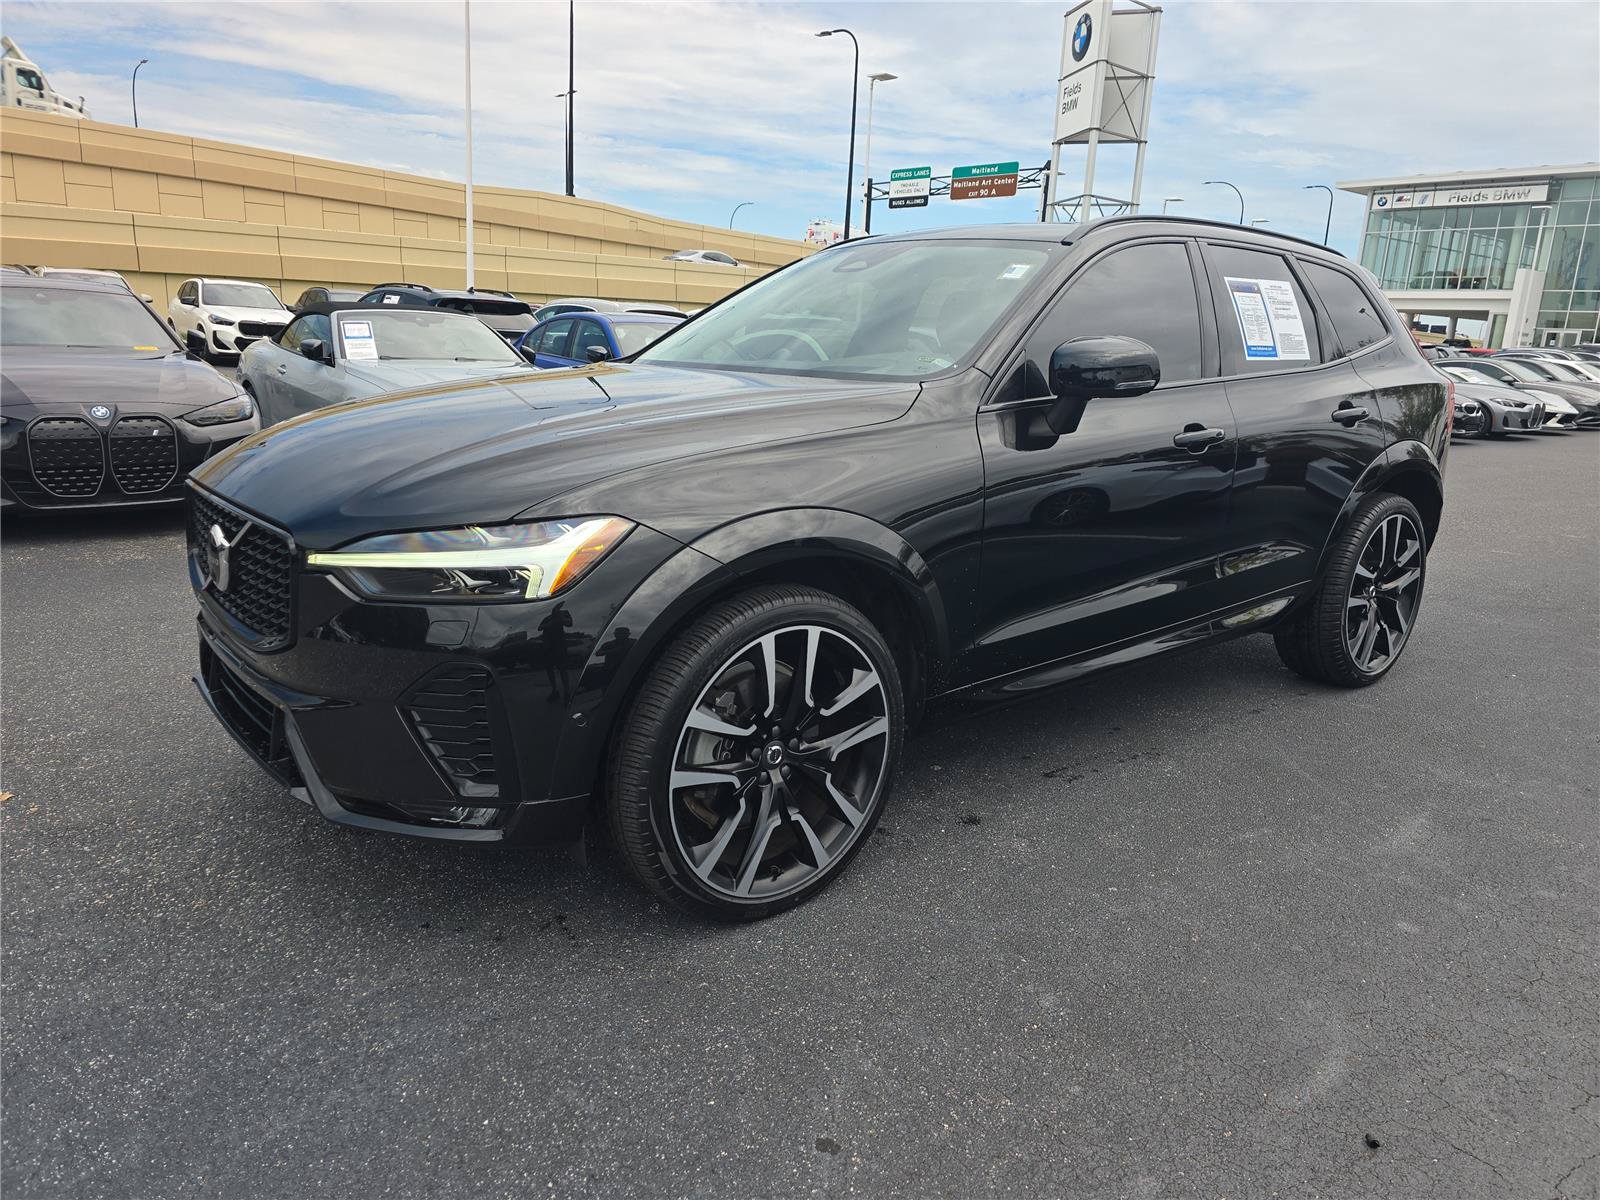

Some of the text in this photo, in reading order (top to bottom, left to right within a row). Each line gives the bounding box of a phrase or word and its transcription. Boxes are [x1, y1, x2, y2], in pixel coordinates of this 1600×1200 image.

[1063, 83, 1081, 99] Fields
[1062, 97, 1078, 114] BMW
[972, 166, 998, 174] Maitland
[953, 180, 979, 188] Maitland
[1448, 189, 1531, 203] Fields BMW
